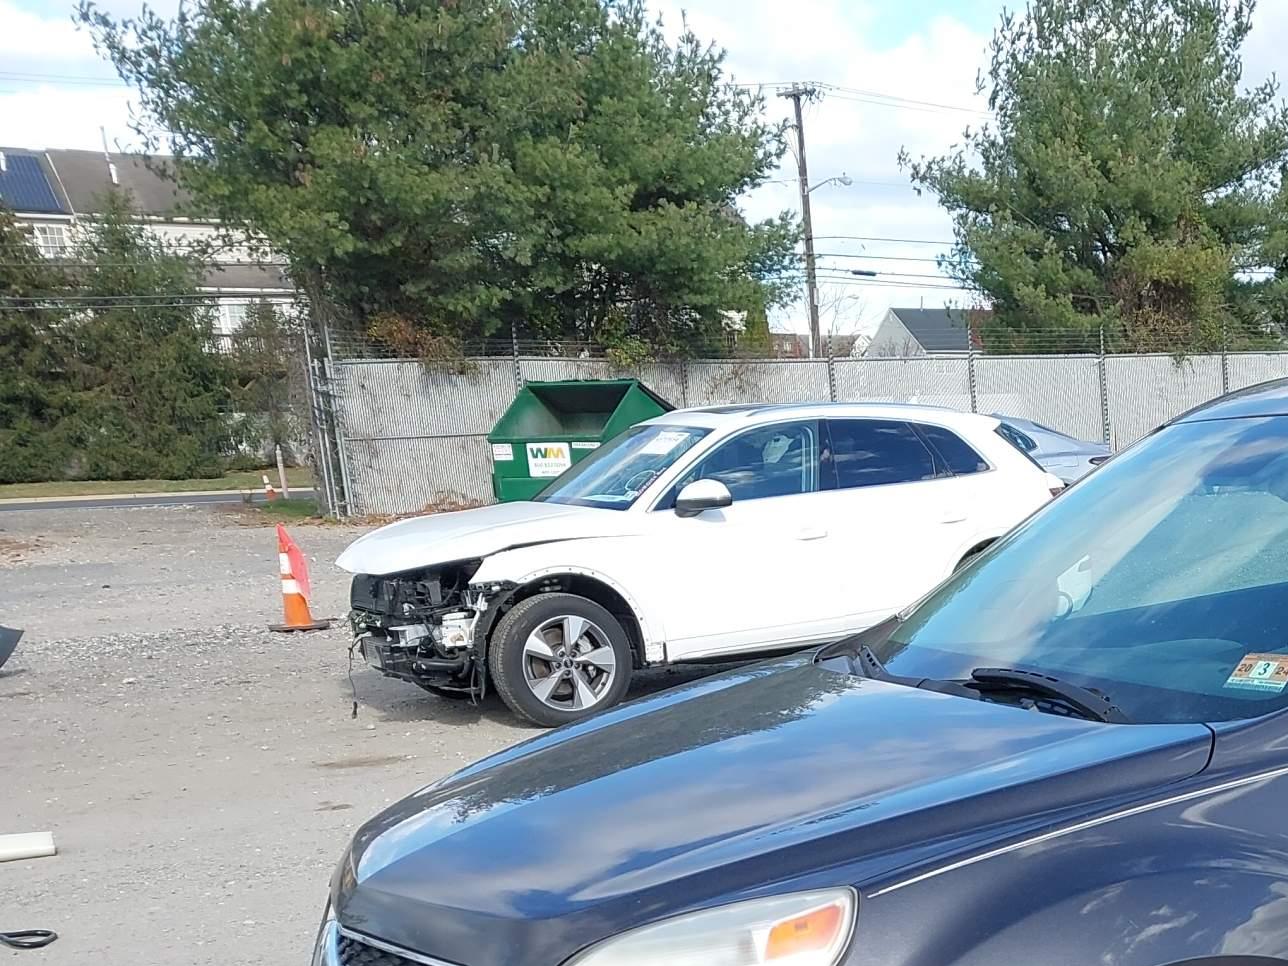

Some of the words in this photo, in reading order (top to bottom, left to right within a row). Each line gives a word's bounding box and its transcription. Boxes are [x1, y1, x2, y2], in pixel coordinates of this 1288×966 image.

[529, 447, 565, 458] WM
[1238, 664, 1253, 672] 20
[1258, 662, 1270, 675] 3
